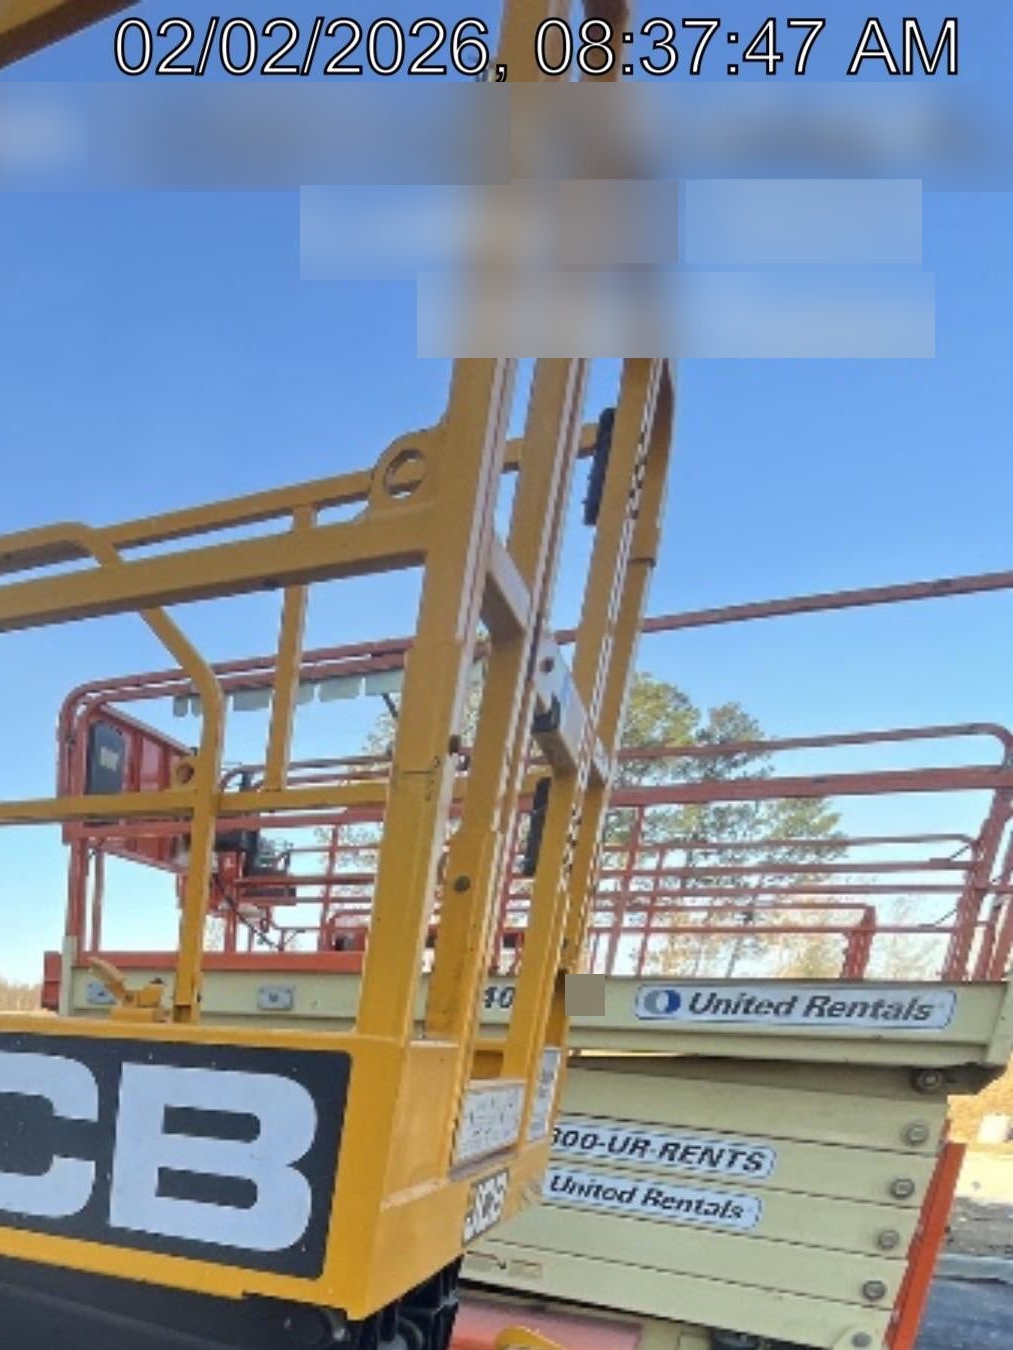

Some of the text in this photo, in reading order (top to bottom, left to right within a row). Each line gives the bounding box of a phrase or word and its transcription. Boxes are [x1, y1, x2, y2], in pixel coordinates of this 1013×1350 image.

[688, 991, 934, 1022] United Rentals
[549, 1174, 745, 1220] United Rentals
